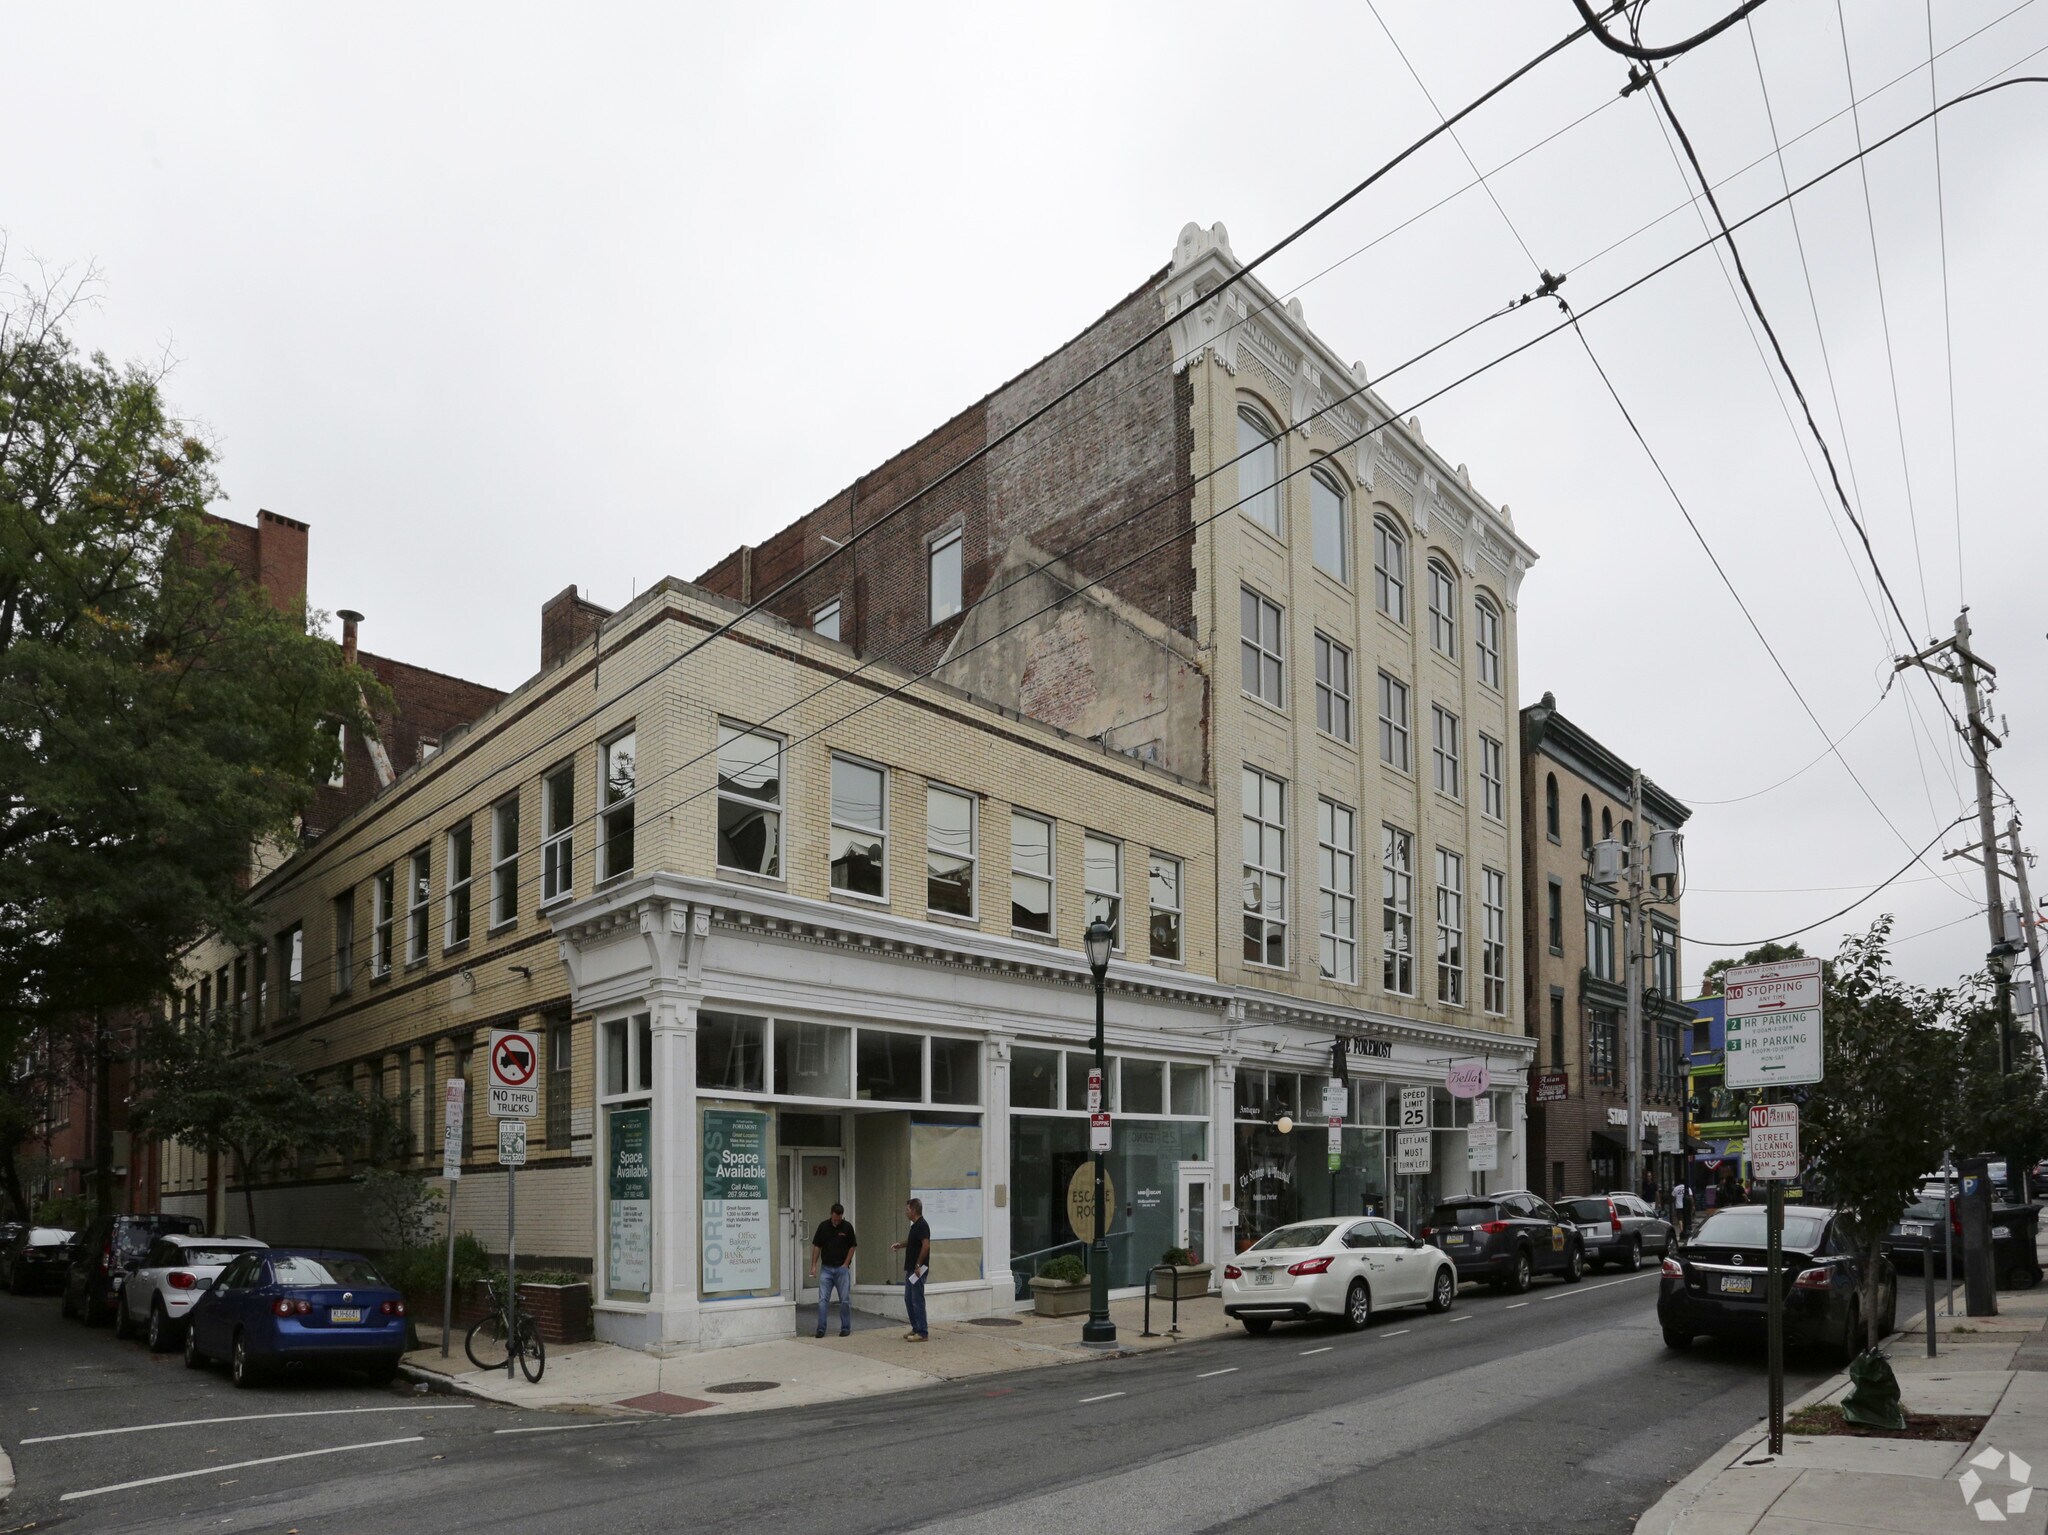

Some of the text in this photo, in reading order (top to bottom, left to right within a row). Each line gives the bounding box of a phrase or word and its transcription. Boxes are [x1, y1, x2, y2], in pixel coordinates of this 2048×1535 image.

[1727, 981, 1802, 999] NO STOPPING
[1731, 1013, 1806, 1030] 2 HR PARKING
[1353, 1037, 1392, 1058] FOREMOST
[1731, 1034, 1806, 1050] 3 HR PARKING
[1450, 1070, 1477, 1083] Bella
[493, 1090, 533, 1102] NO THRU
[1403, 1091, 1425, 1099] SPEED
[497, 1103, 529, 1112] TRUCKS
[1405, 1110, 1424, 1125] 25
[1751, 1110, 1794, 1127] NO PARKING
[446, 1128, 450, 1138] 2
[1758, 1133, 1789, 1141] STREET
[1755, 1141, 1793, 1150] CLEANING
[620, 1150, 642, 1166] Space
[722, 1150, 758, 1166] Space
[1405, 1148, 1423, 1157] MUST
[1753, 1150, 1795, 1159] WEDNESDAY
[617, 1164, 648, 1178] Available
[716, 1165, 766, 1178] Available
[813, 1166, 827, 1176] 519
[1755, 1162, 1769, 1170] 3AM
[1778, 1161, 1795, 1170] 5AM
[1963, 1180, 1974, 1192] P
[705, 1111, 723, 1284] FOREMOST
[1072, 1191, 1110, 1203] ESCAE
[1077, 1206, 1095, 1219] ROO
[1367, 1206, 1373, 1215] P
